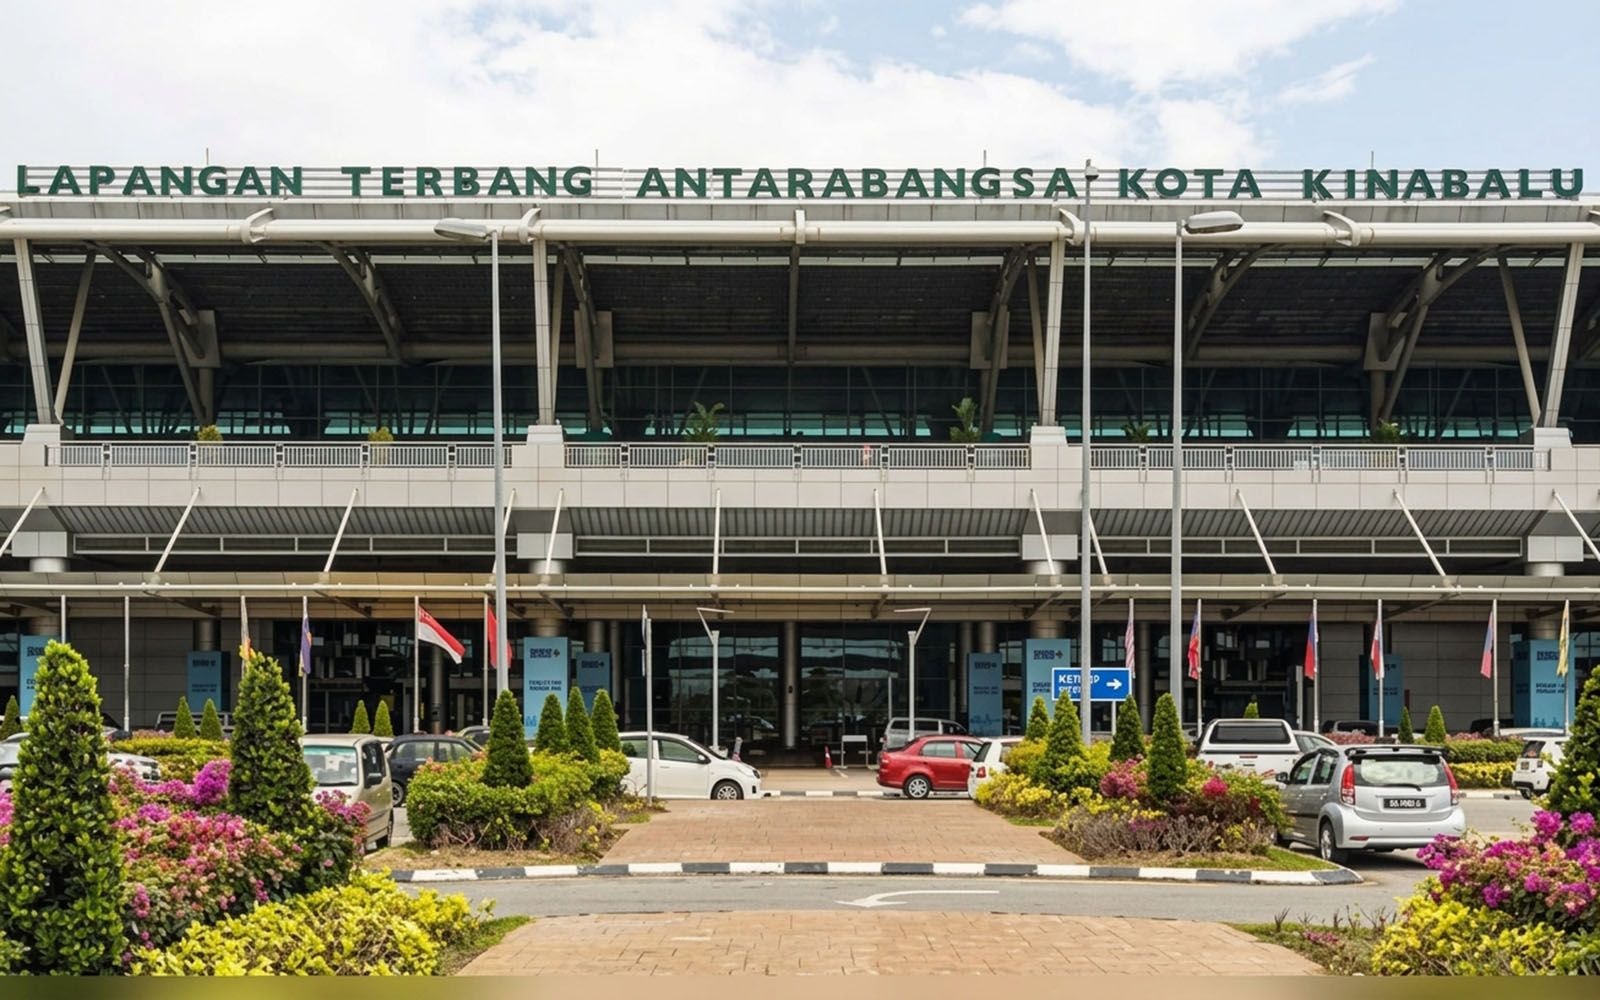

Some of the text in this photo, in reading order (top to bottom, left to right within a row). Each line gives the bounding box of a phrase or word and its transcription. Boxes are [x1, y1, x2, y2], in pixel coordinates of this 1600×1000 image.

[17, 165, 1584, 201] LAPANGAN TERBANG ANTARABANGSA KOTA KINABALU
